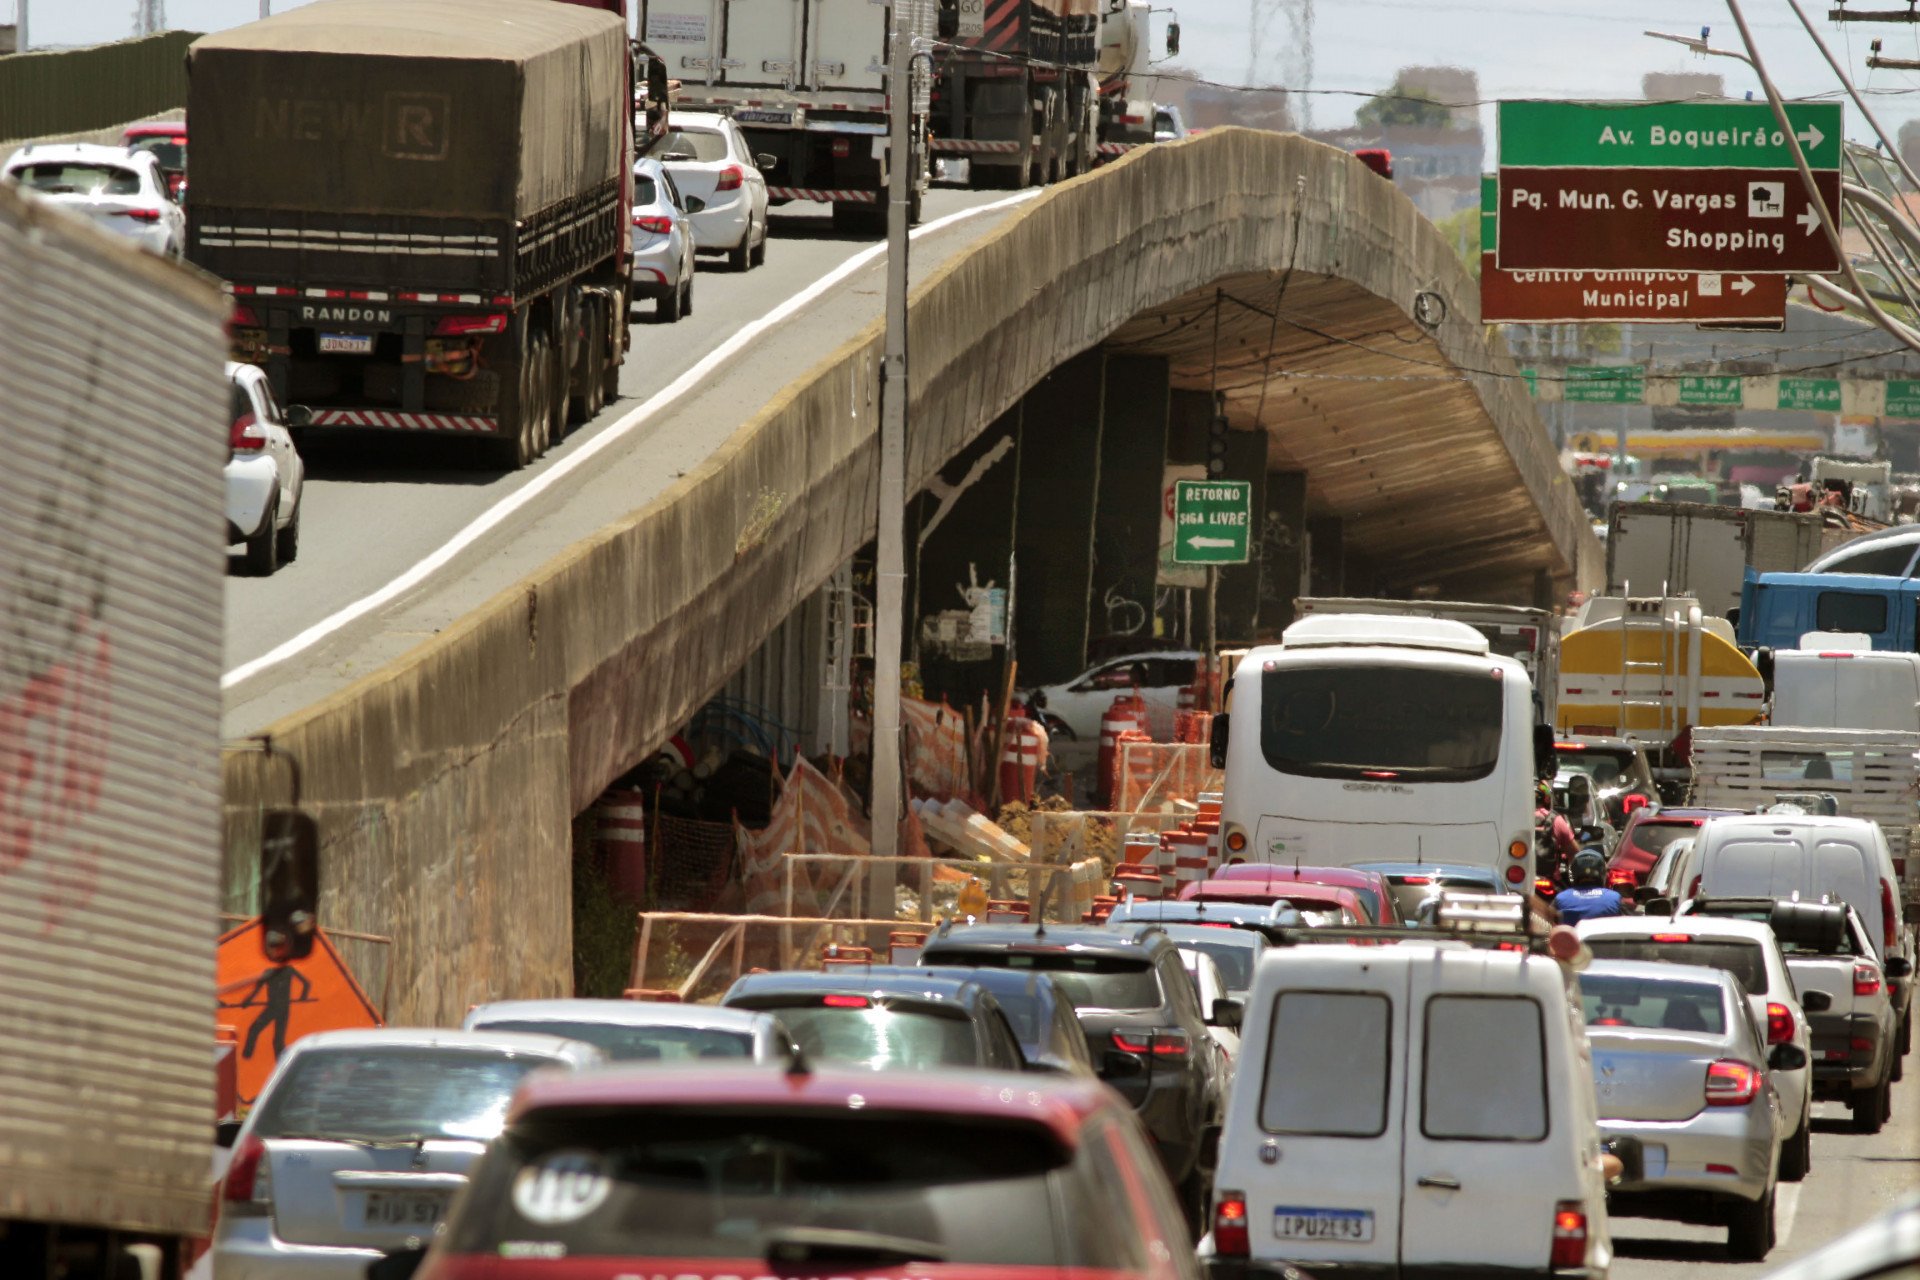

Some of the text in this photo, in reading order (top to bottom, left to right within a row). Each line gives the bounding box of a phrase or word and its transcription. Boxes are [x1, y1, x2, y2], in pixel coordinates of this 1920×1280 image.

[1598, 126, 1634, 145] Av.
[1511, 188, 1736, 213] Pq. Mun. G. Vargas
[1666, 228, 1785, 254] Shopping
[1583, 290, 1688, 310] Municipal
[302, 306, 390, 322] RANDON
[1186, 487, 1240, 501] RETORNO
[1179, 512, 1247, 525] SIGA LIVRE
